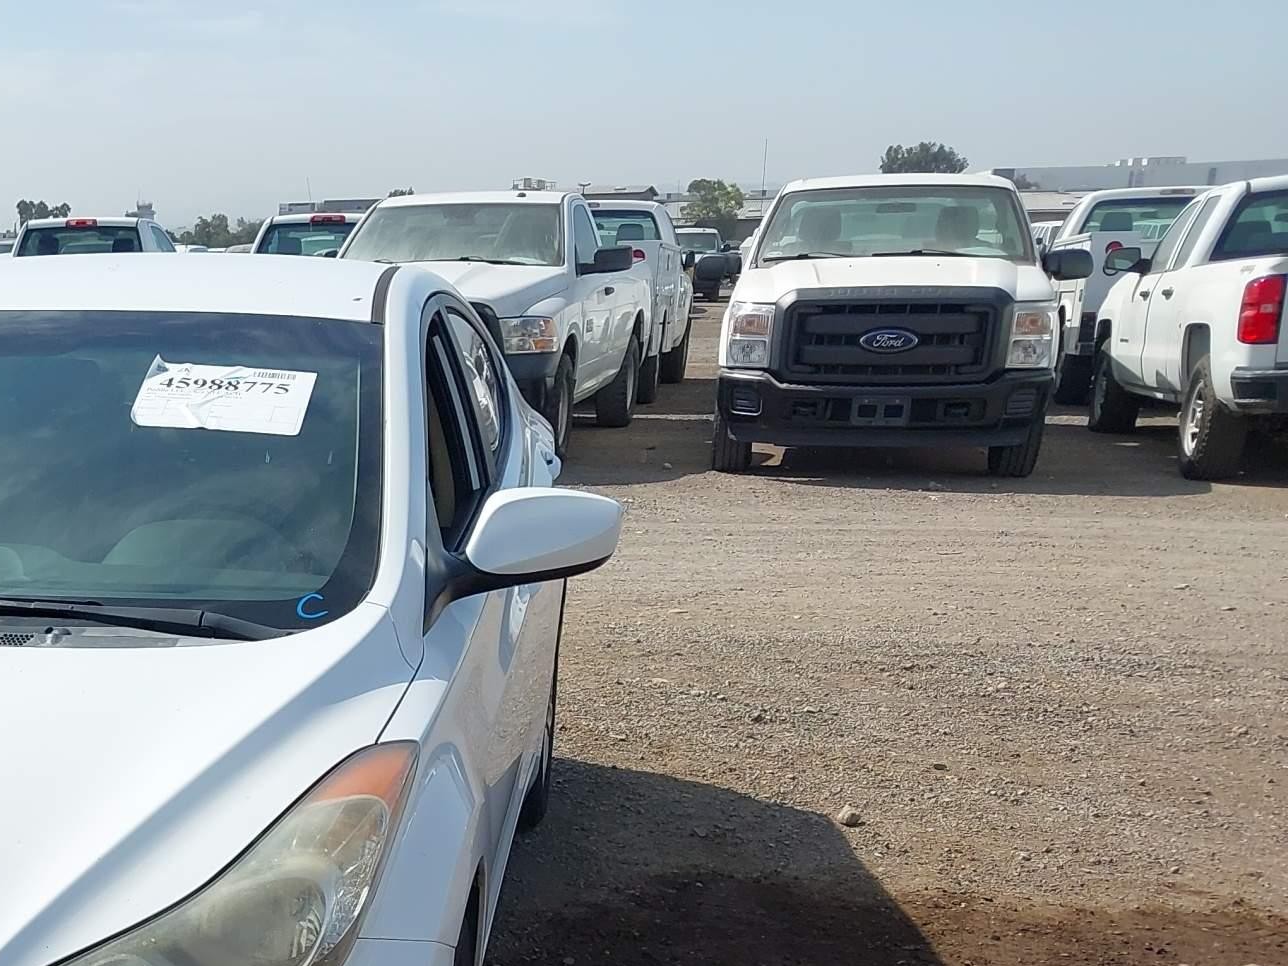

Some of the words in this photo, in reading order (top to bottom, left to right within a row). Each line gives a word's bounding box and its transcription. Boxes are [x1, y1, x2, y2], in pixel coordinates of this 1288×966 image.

[872, 333, 905, 347] Ford
[159, 377, 290, 395] 45988775
[297, 593, 329, 619] C
